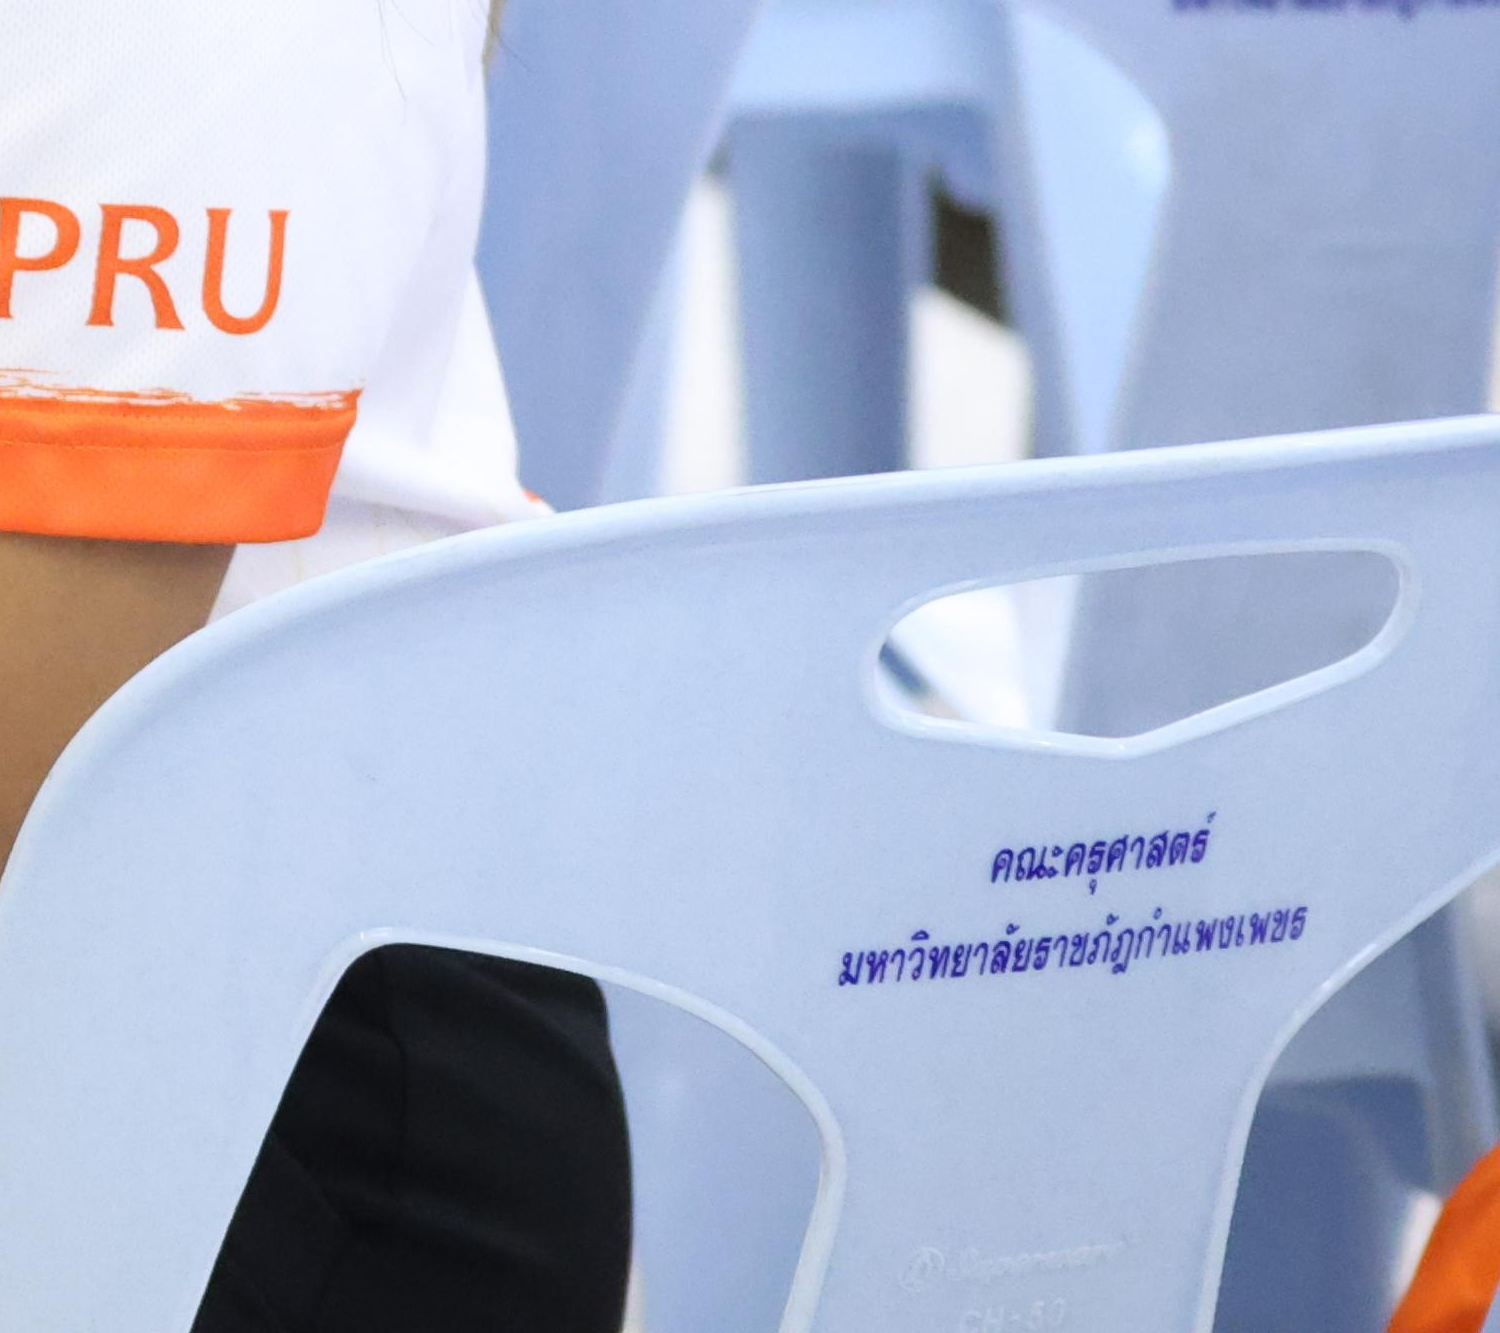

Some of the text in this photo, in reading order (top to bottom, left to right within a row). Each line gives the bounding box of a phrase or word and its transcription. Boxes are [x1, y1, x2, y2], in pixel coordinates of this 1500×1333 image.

[990, 811, 1217, 895] คณะครุศาสตร์
